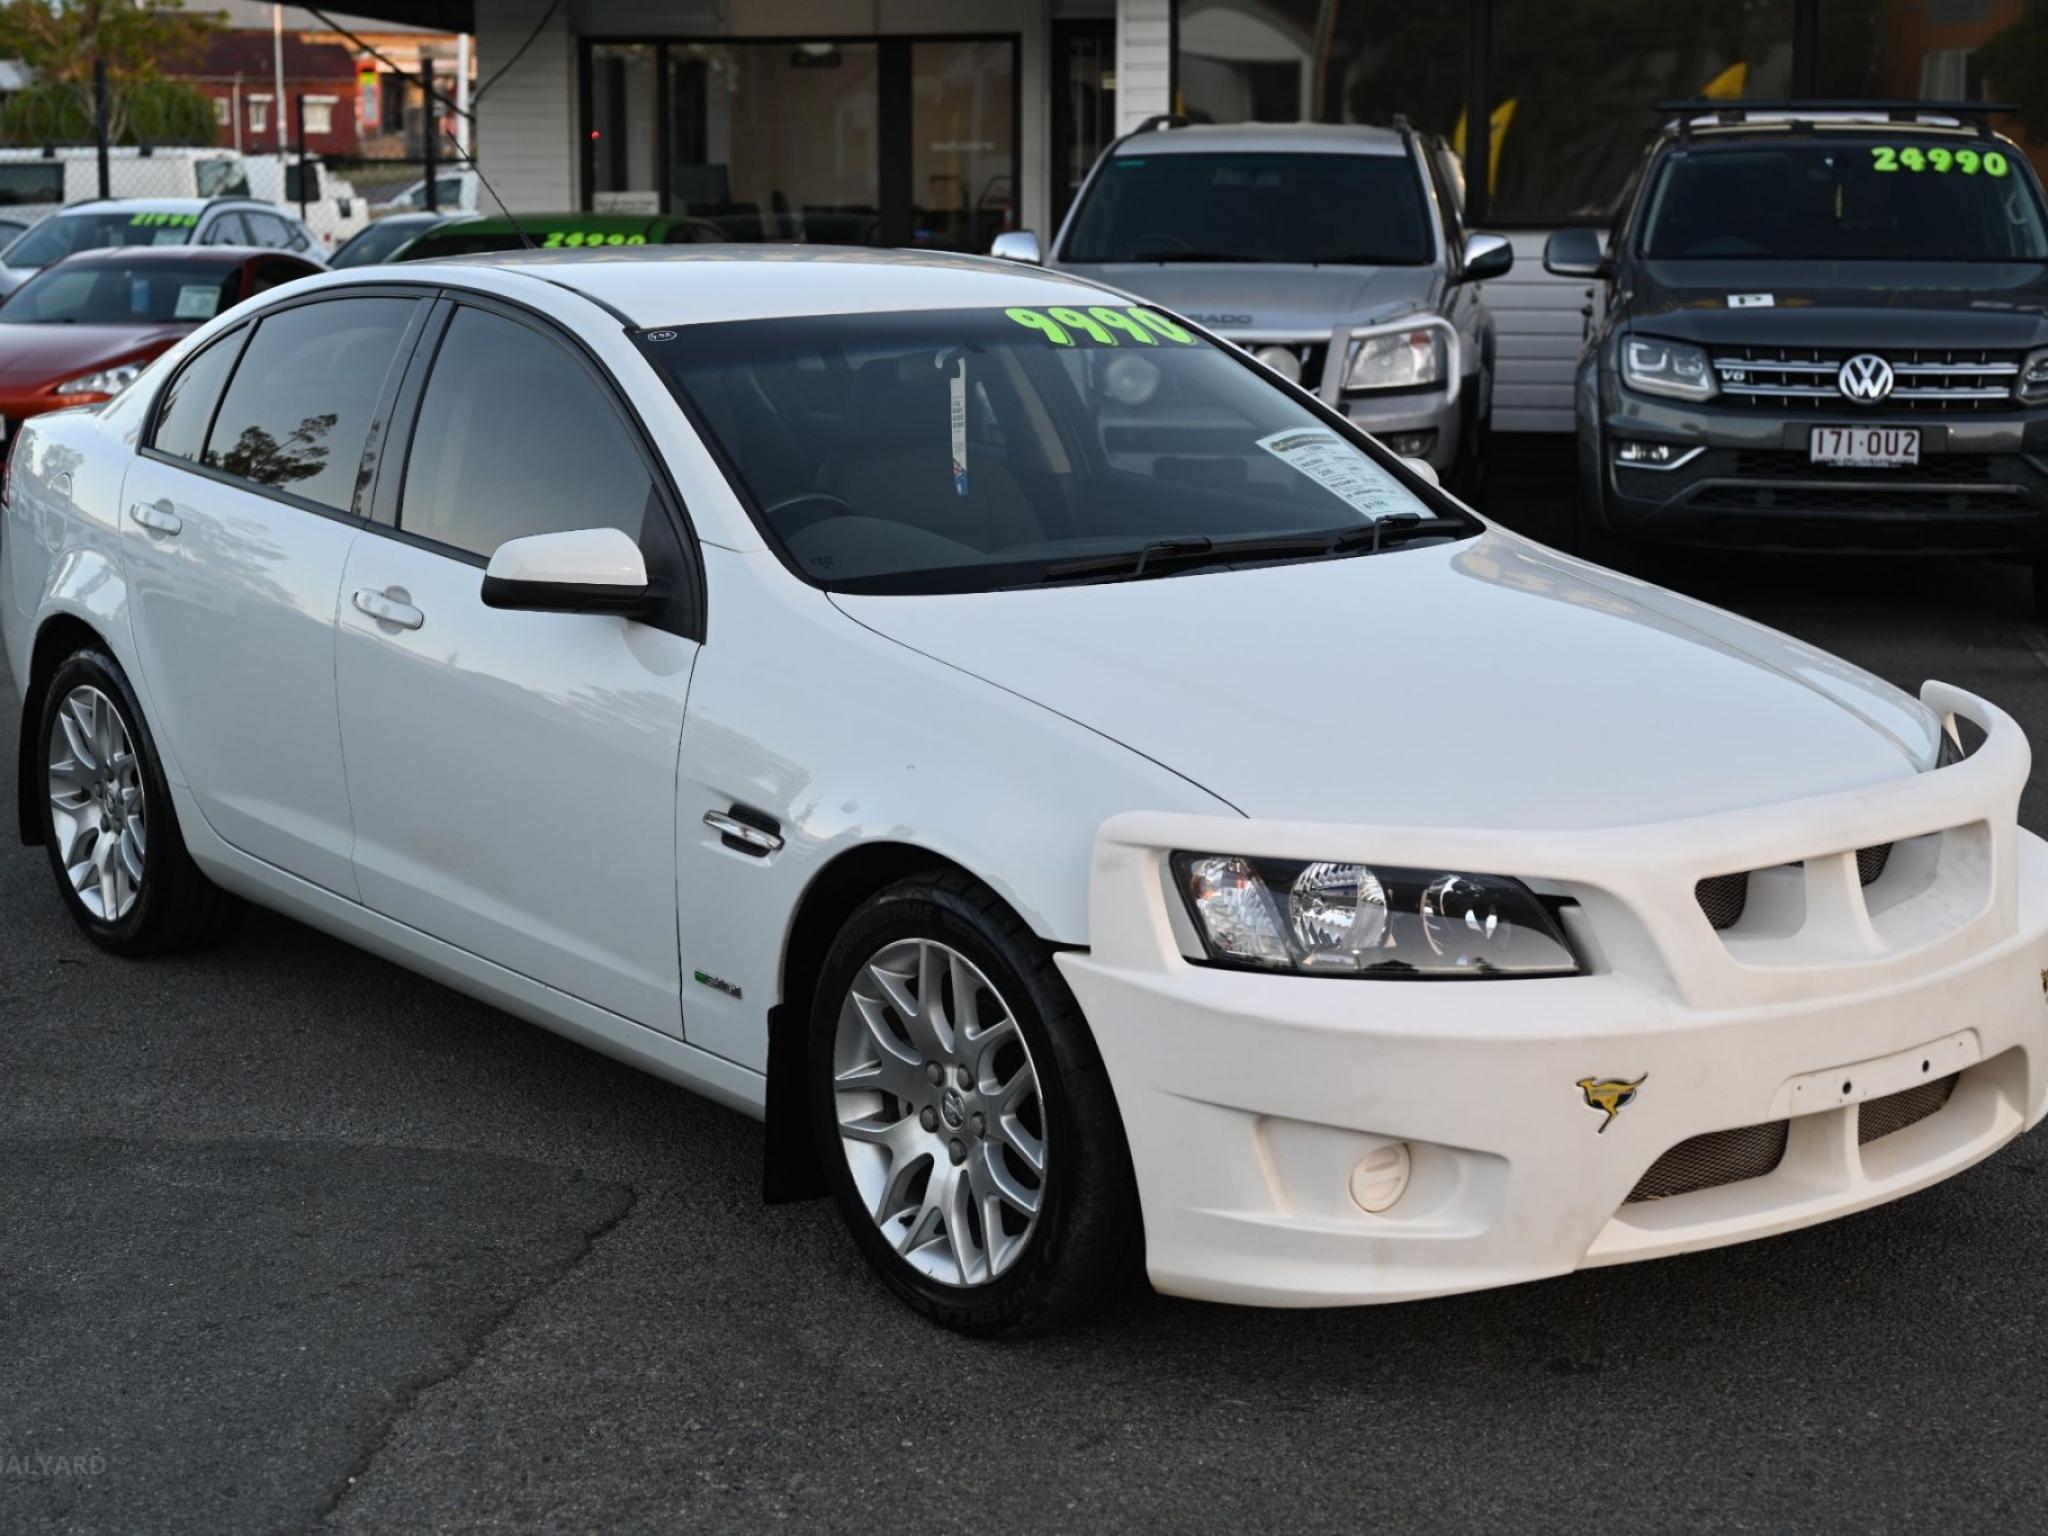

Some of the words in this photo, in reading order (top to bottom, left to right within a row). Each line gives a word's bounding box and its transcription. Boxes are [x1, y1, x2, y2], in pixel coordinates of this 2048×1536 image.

[1871, 146, 2009, 177] 24990
[1004, 307, 1198, 346] 9990
[1721, 368, 1745, 381] V6
